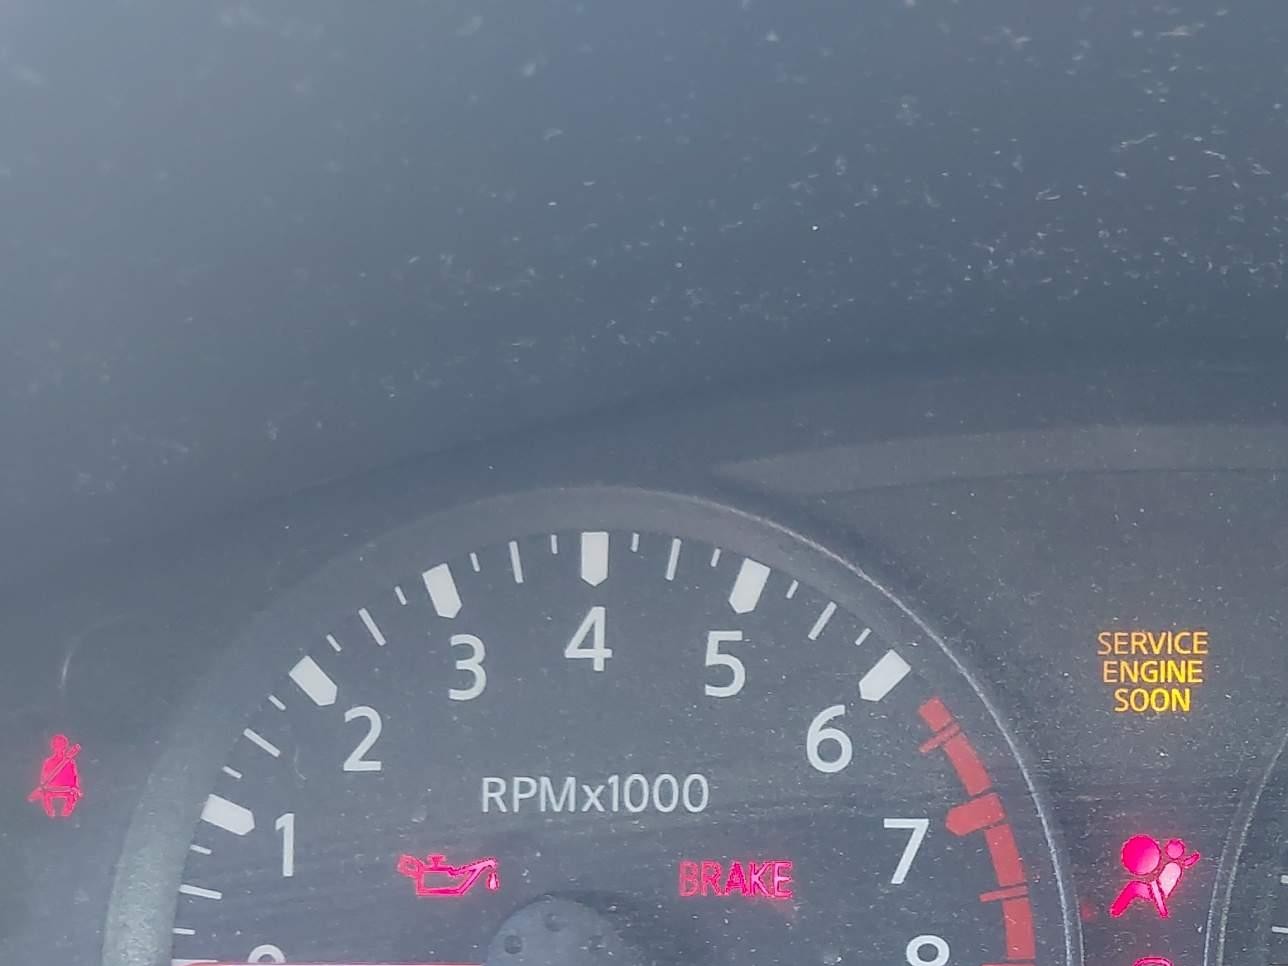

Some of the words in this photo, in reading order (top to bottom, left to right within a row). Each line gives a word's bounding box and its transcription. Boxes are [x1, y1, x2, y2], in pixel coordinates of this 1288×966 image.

[448, 633, 487, 701] 3
[563, 605, 613, 672] 4
[704, 629, 747, 698] 5
[1097, 631, 1209, 655] SERVICE
[1102, 660, 1204, 684] ENGINE
[1114, 688, 1192, 713] SOON
[343, 706, 383, 772] 2
[805, 705, 853, 773] 6
[481, 773, 709, 814] RPMx1000
[275, 813, 295, 877] 1
[883, 819, 930, 885] 7
[679, 860, 793, 899] BRAKE
